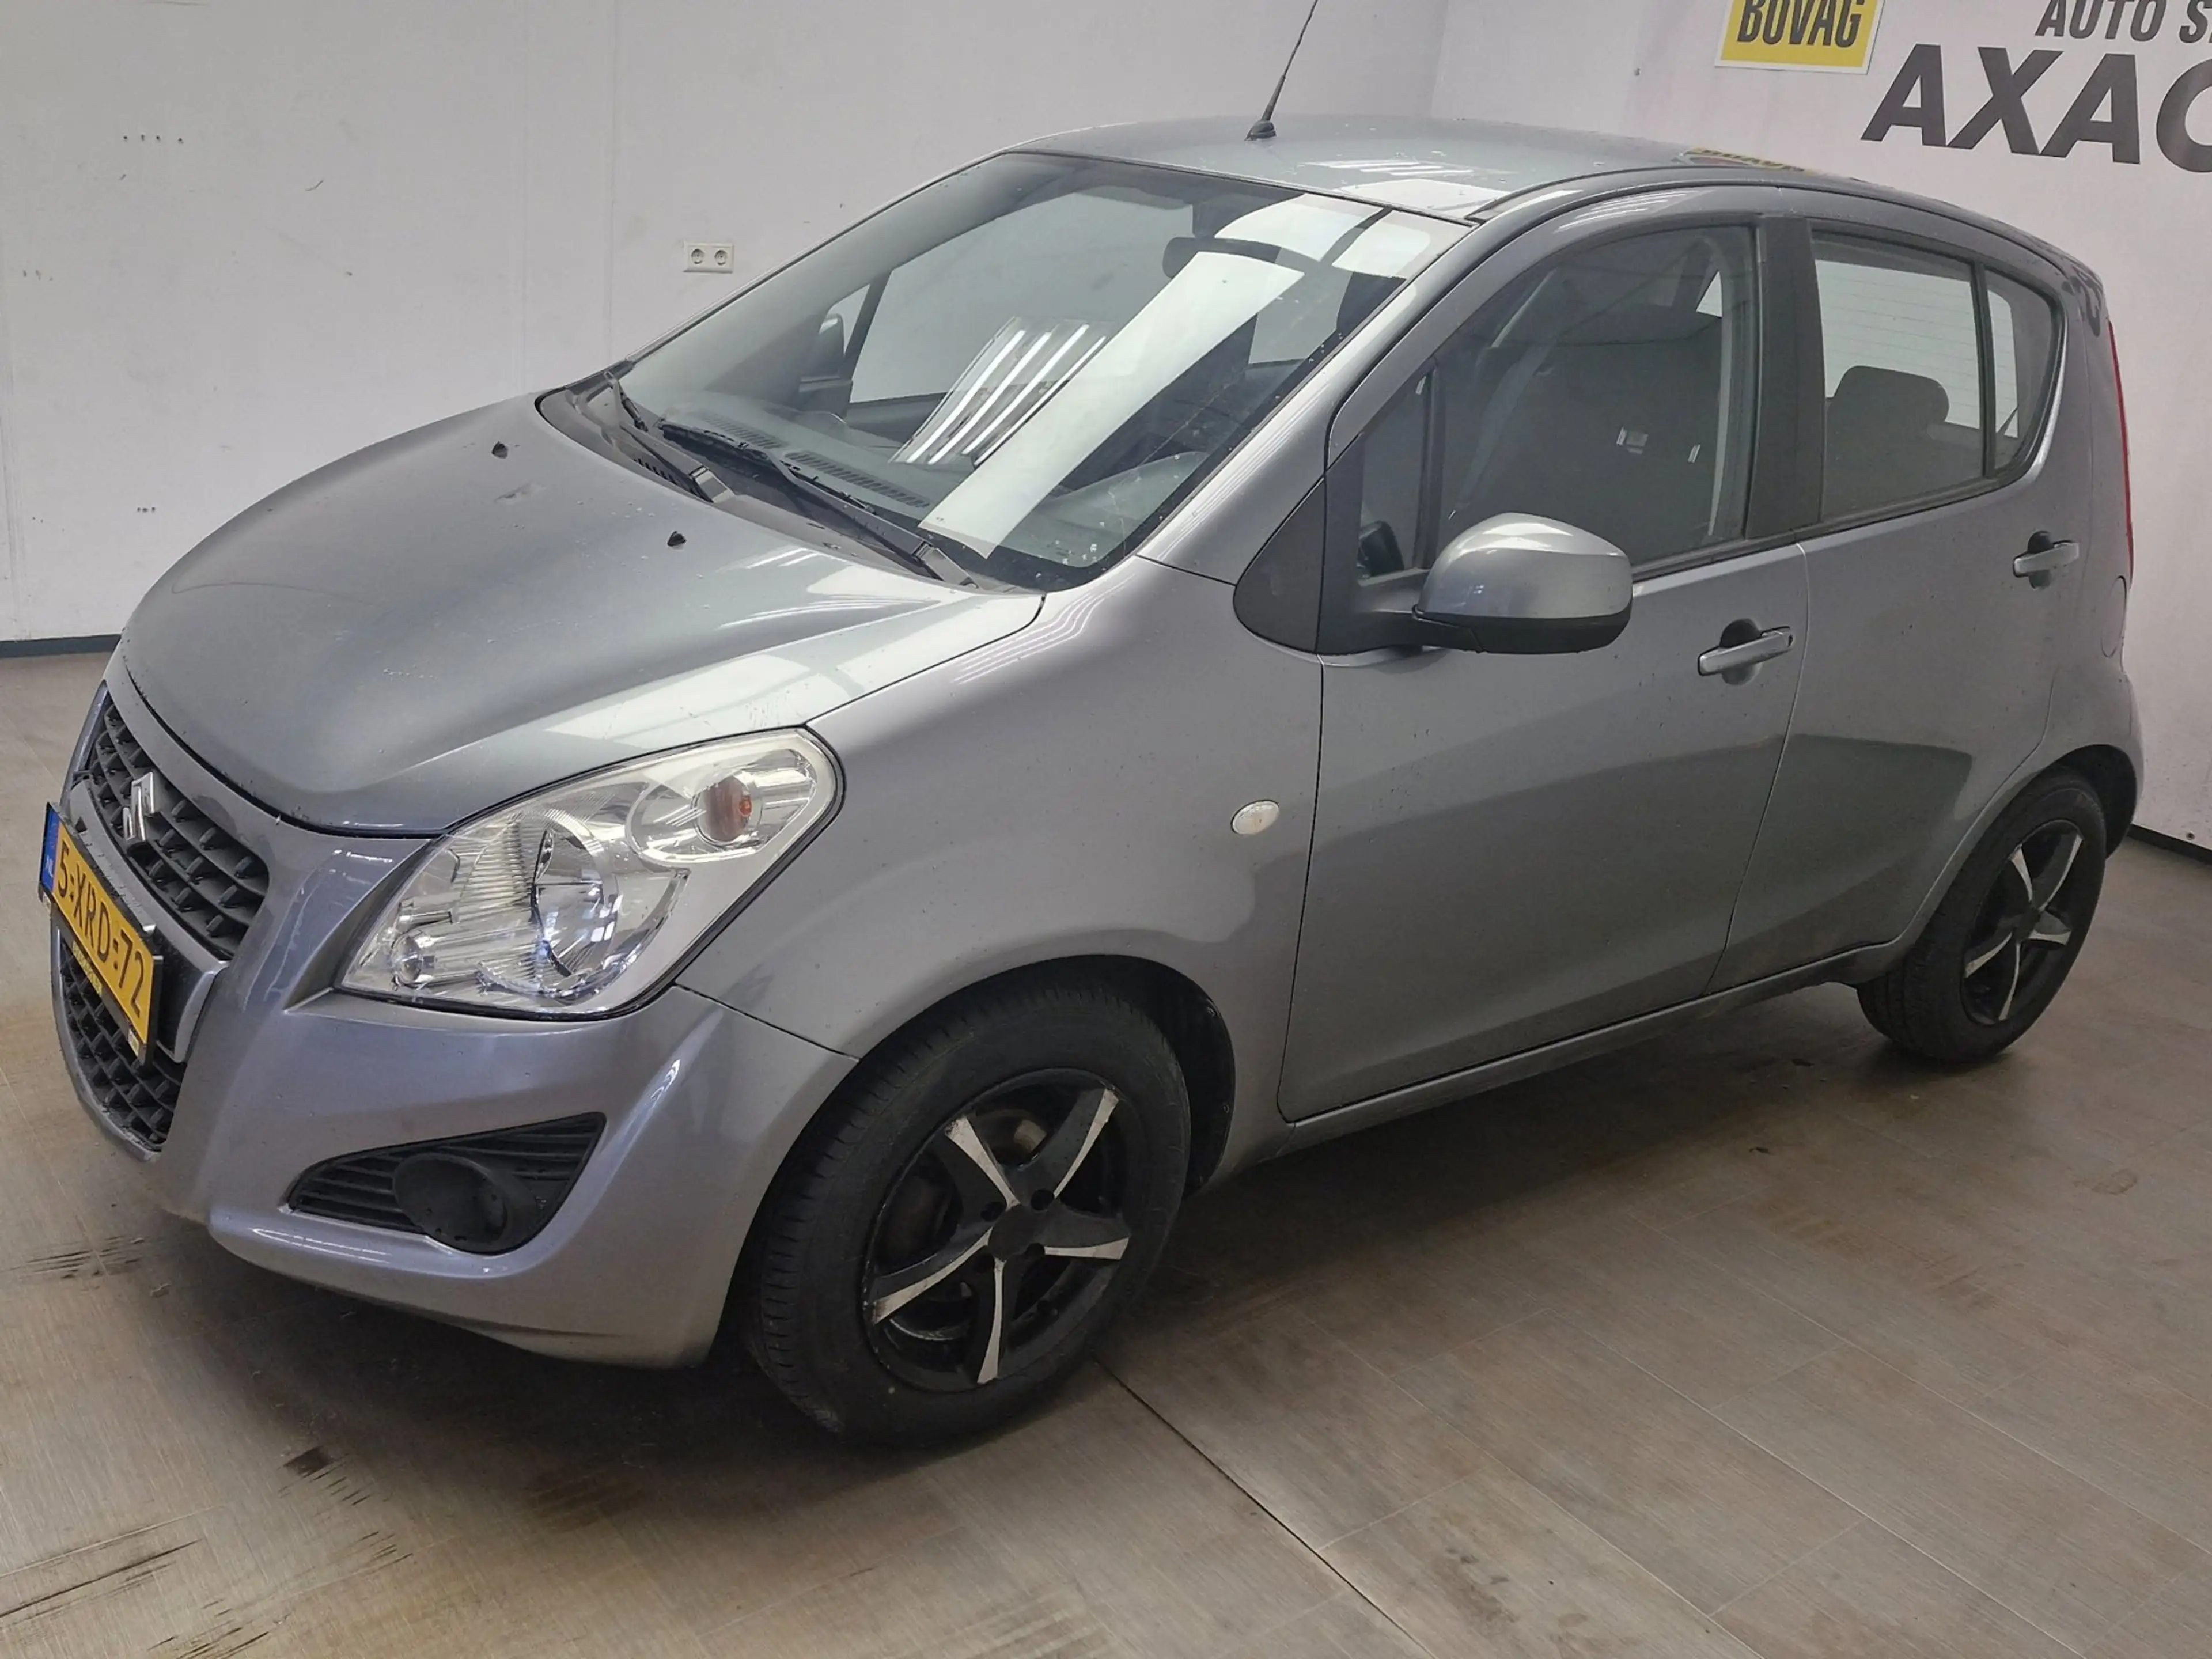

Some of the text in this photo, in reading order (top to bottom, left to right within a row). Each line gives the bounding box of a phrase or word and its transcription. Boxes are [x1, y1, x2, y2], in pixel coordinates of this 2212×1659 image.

[1737, 0, 1865, 48] BOVAG
[2035, 0, 2212, 43] AUTO S
